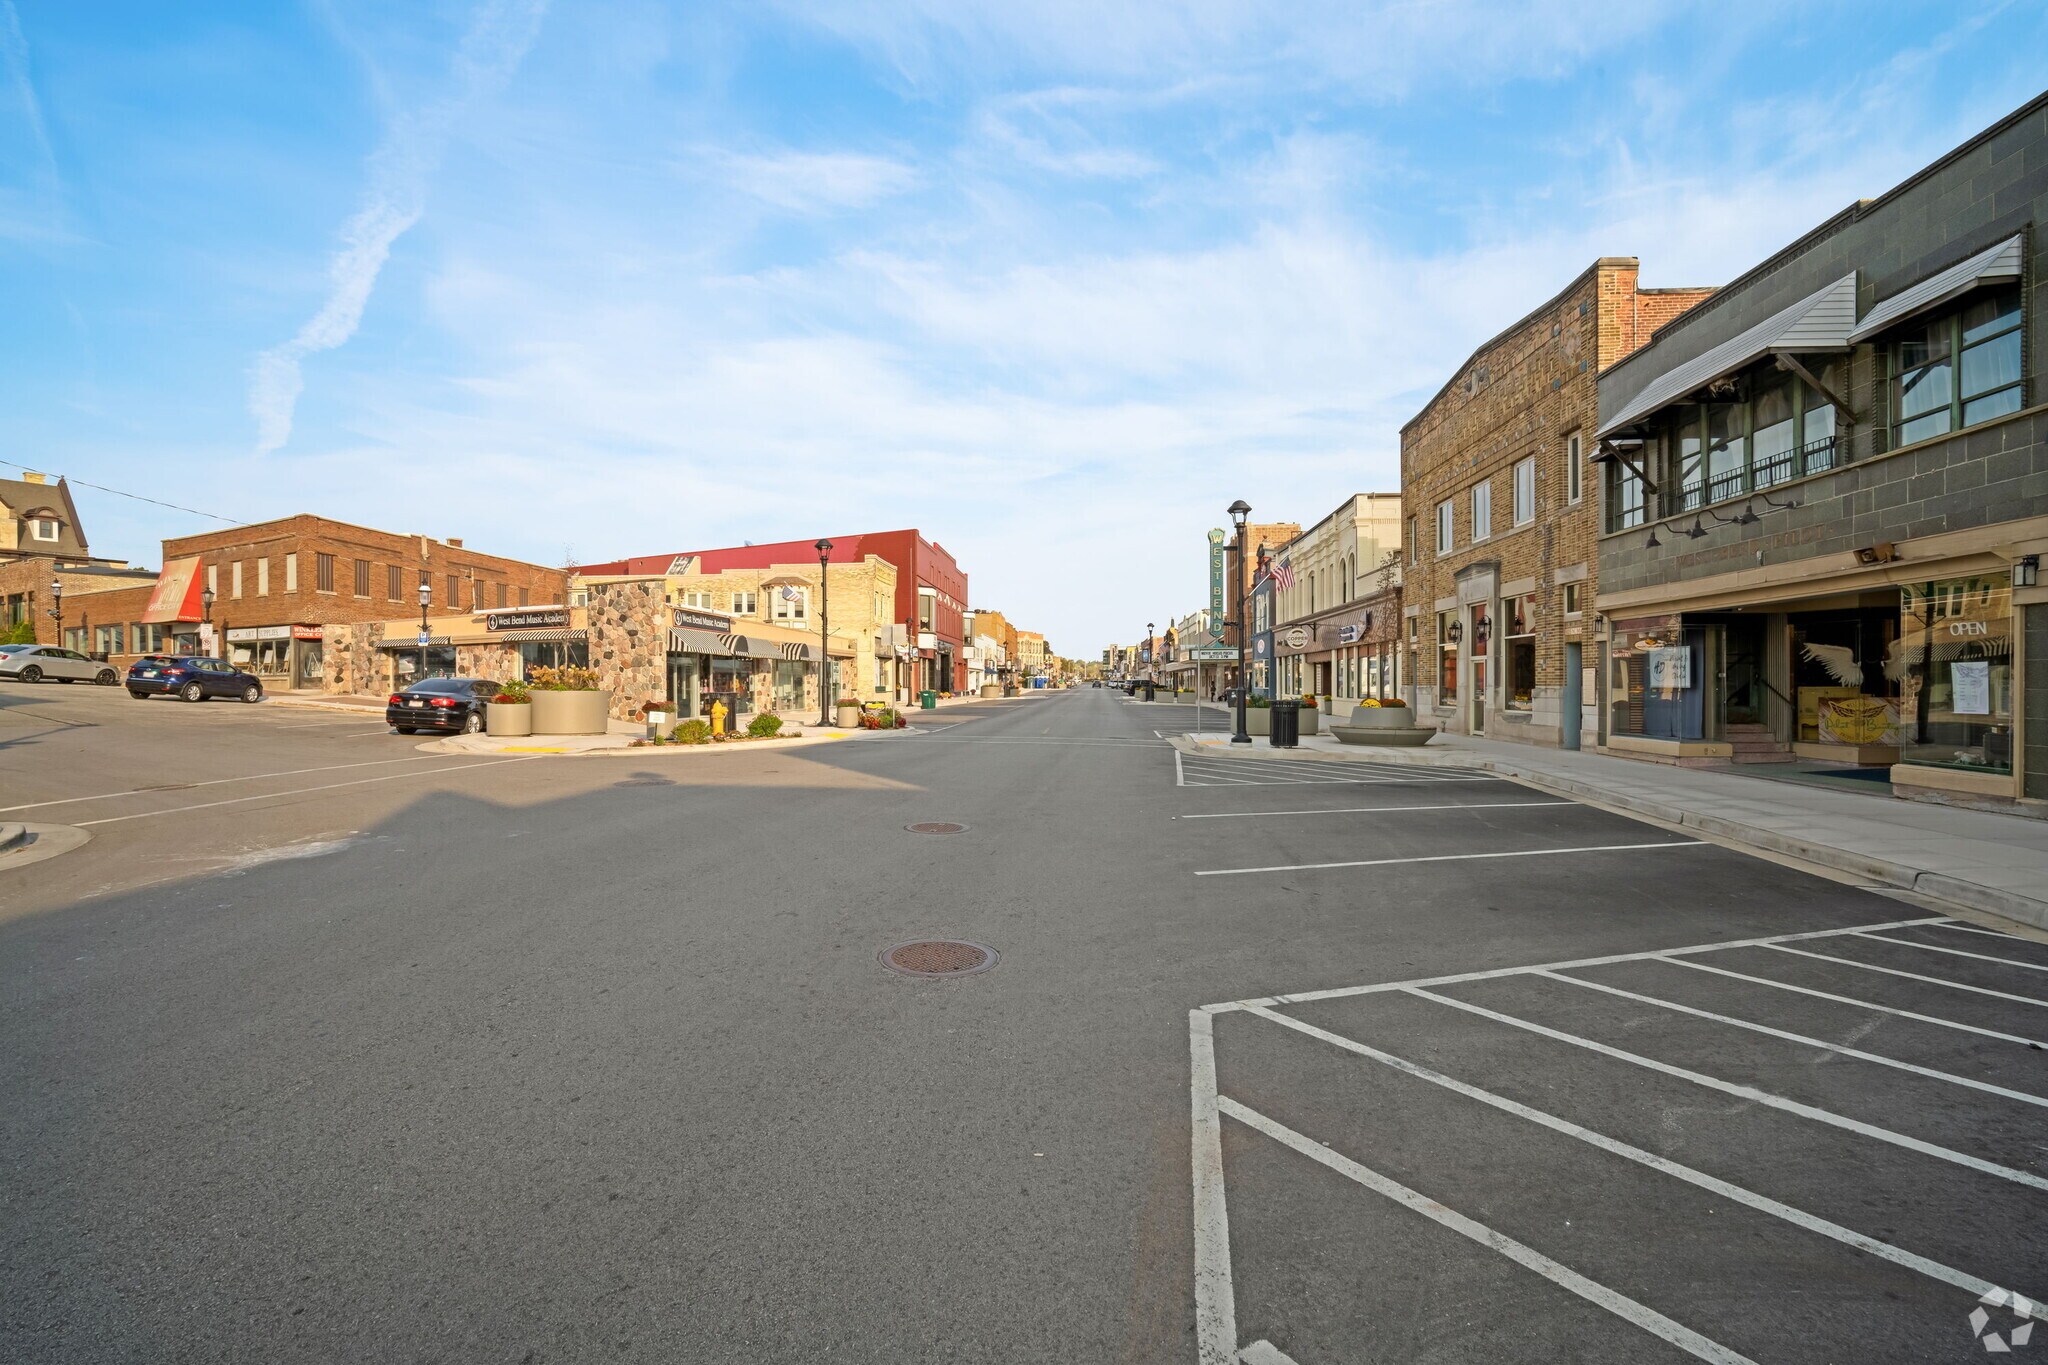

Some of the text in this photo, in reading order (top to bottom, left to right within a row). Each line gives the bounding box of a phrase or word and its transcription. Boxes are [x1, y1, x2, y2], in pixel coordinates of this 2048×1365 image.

[1212, 535, 1222, 632] WEST BEND
[498, 616, 511, 625] West
[511, 614, 525, 625] Bend
[526, 613, 543, 624] Music
[682, 613, 730, 631] West Bend Music Academy
[1950, 622, 1987, 636] OPEN
